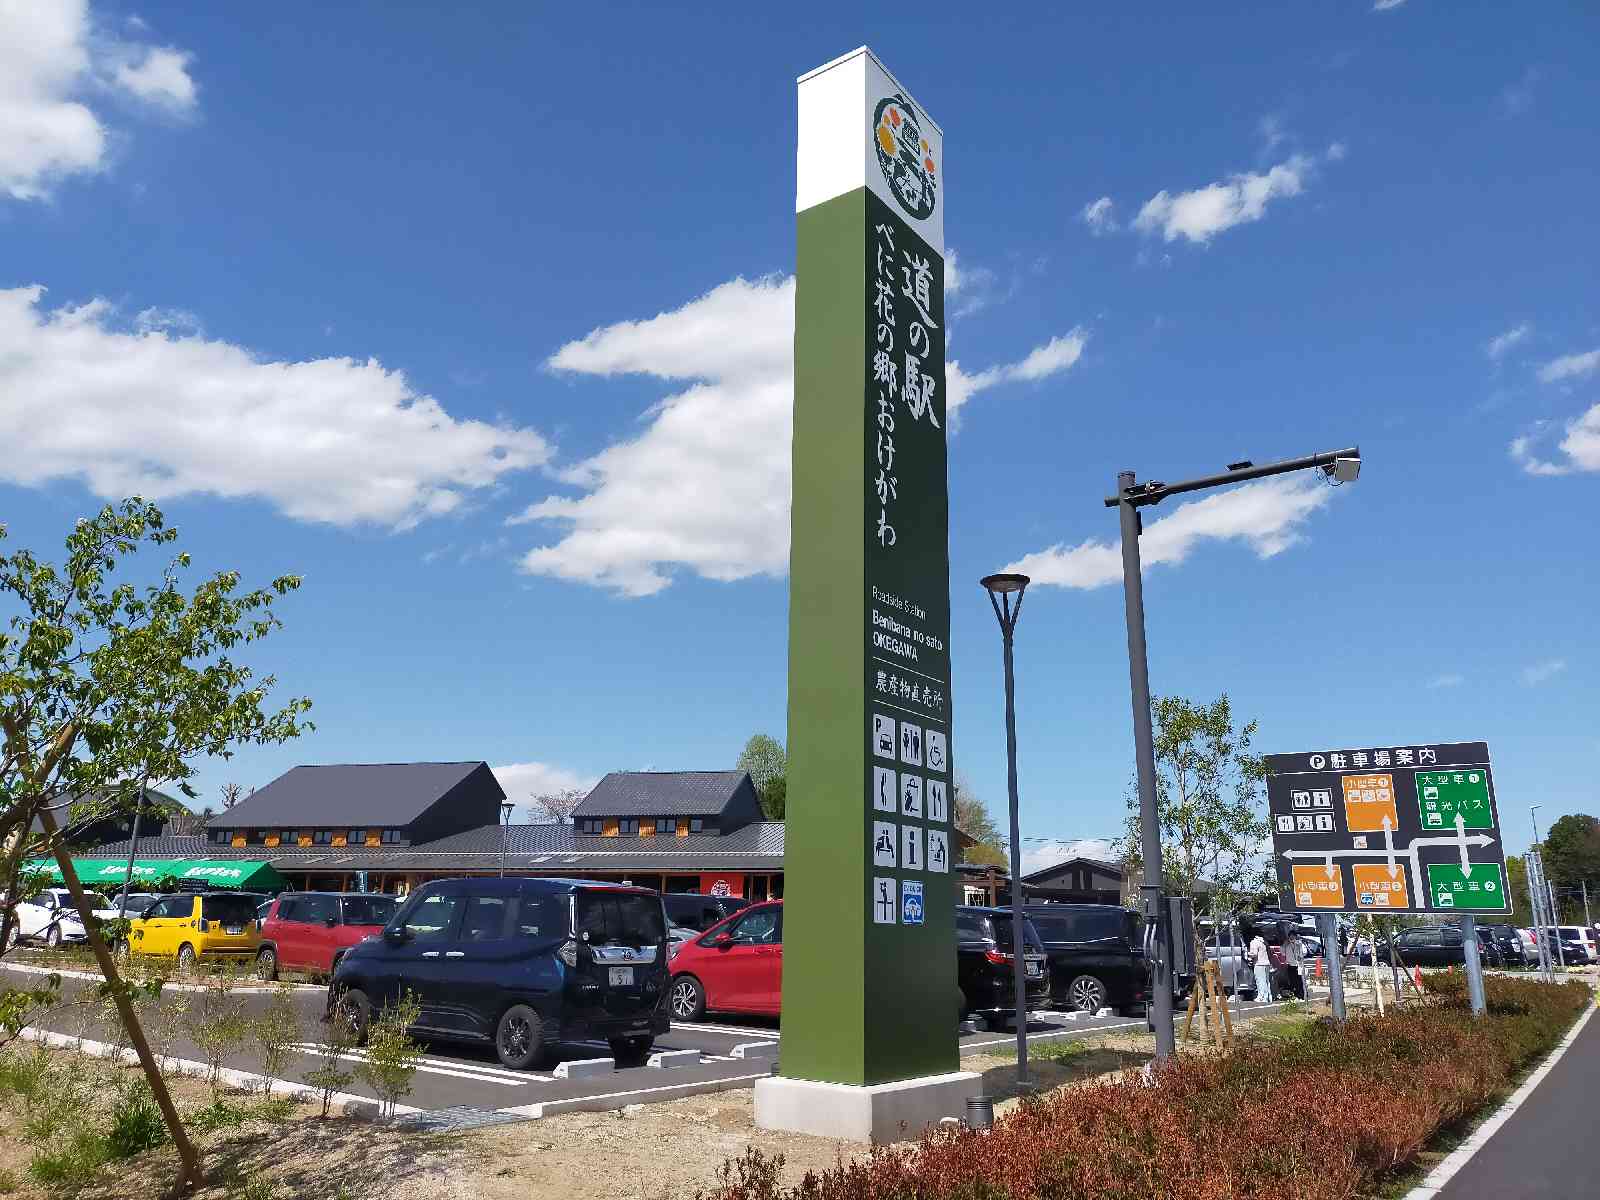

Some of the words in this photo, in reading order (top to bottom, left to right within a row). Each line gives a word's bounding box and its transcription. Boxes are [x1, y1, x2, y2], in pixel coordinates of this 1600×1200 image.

[901, 249, 940, 429] 道の駅
[873, 224, 898, 547] べに花の郷おけがわ
[872, 585, 903, 610] Roadside
[872, 609, 911, 638] Benibana
[913, 630, 924, 643] no
[926, 635, 943, 651] sato
[873, 631, 919, 662] OKEGAWA
[875, 670, 944, 712] 農産物直売所
[1330, 748, 1437, 769] 駐車場案内
